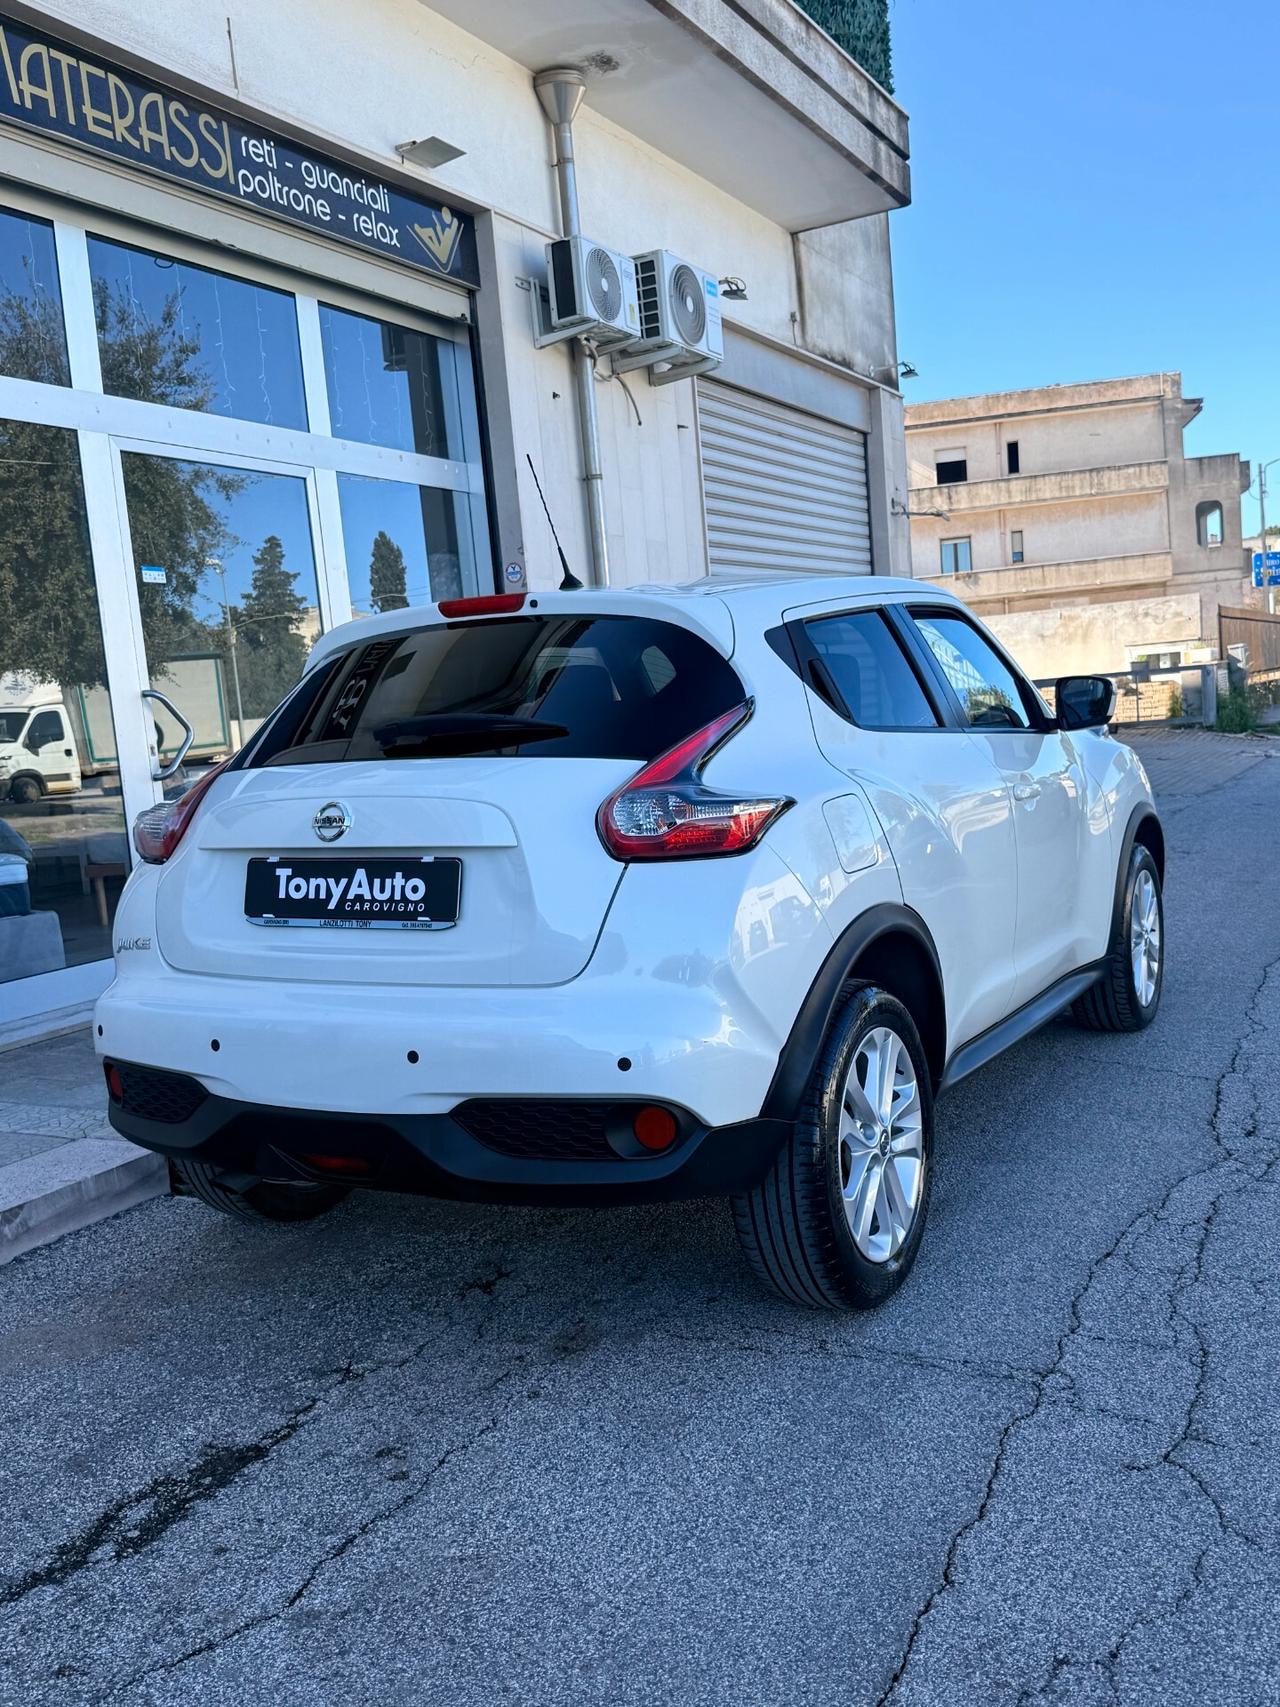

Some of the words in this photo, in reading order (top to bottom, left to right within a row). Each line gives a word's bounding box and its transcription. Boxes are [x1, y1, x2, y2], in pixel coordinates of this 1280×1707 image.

[240, 134, 277, 166] reti
[301, 161, 391, 214] guanciali
[238, 168, 331, 221] poltrone
[353, 211, 401, 249] relax
[313, 815, 346, 826] NISSAN
[275, 867, 426, 910] TonyAuto
[345, 902, 425, 912] CAROVIGNO
[355, 920, 372, 928] TONY
[116, 936, 152, 954] JUKE
